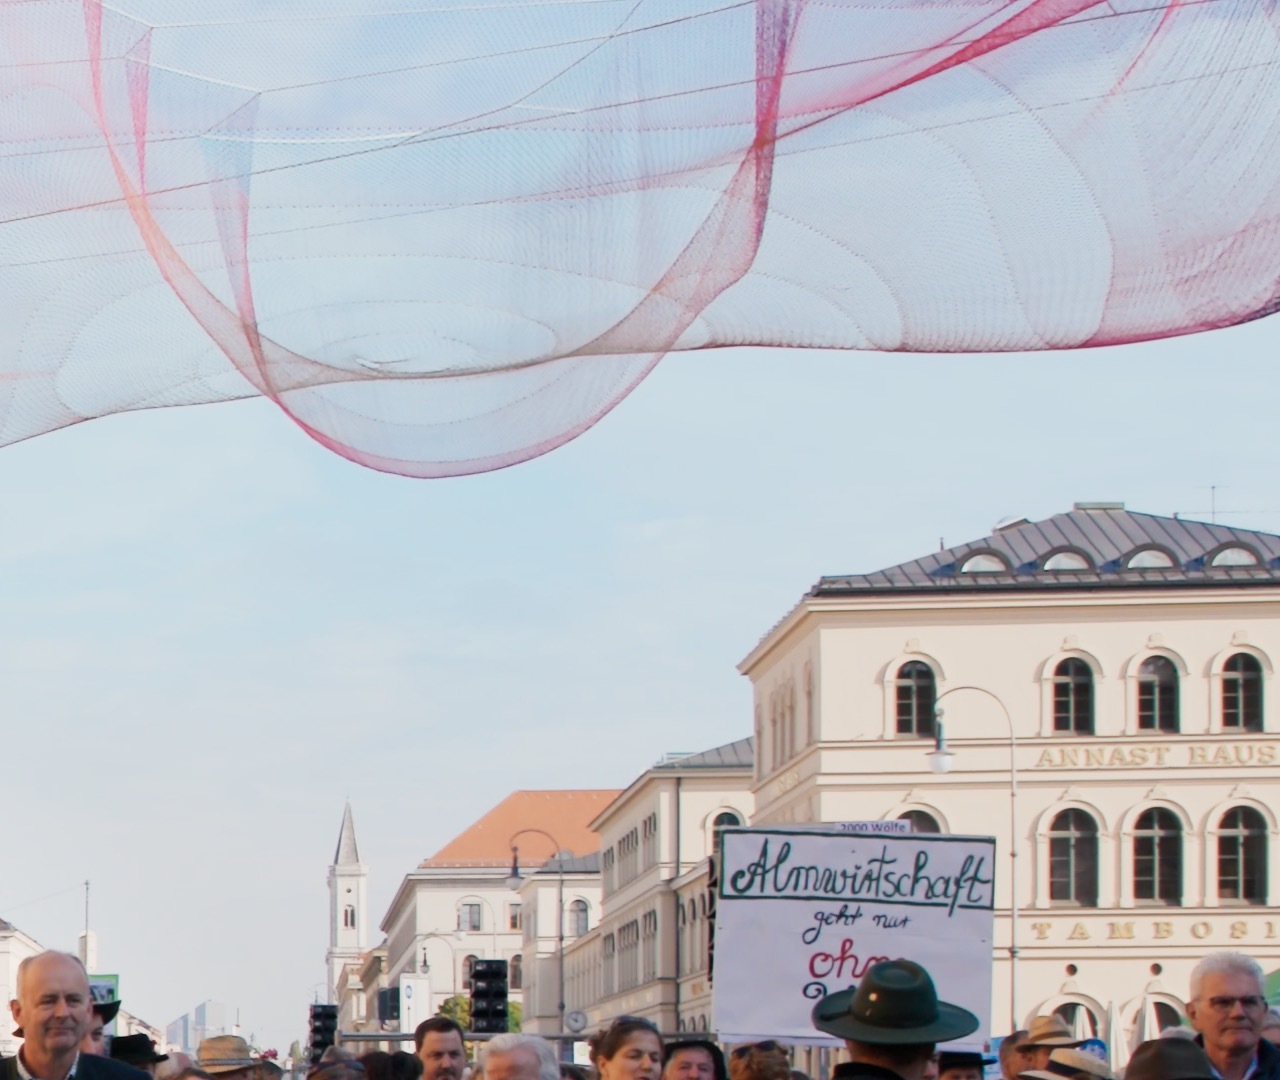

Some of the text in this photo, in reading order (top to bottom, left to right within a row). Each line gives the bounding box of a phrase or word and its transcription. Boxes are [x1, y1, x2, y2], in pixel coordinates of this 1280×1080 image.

[1034, 745, 1277, 768] ANNAST HAUS
[730, 837, 992, 917] Almwirtschaft
[802, 904, 913, 945] geht nur
